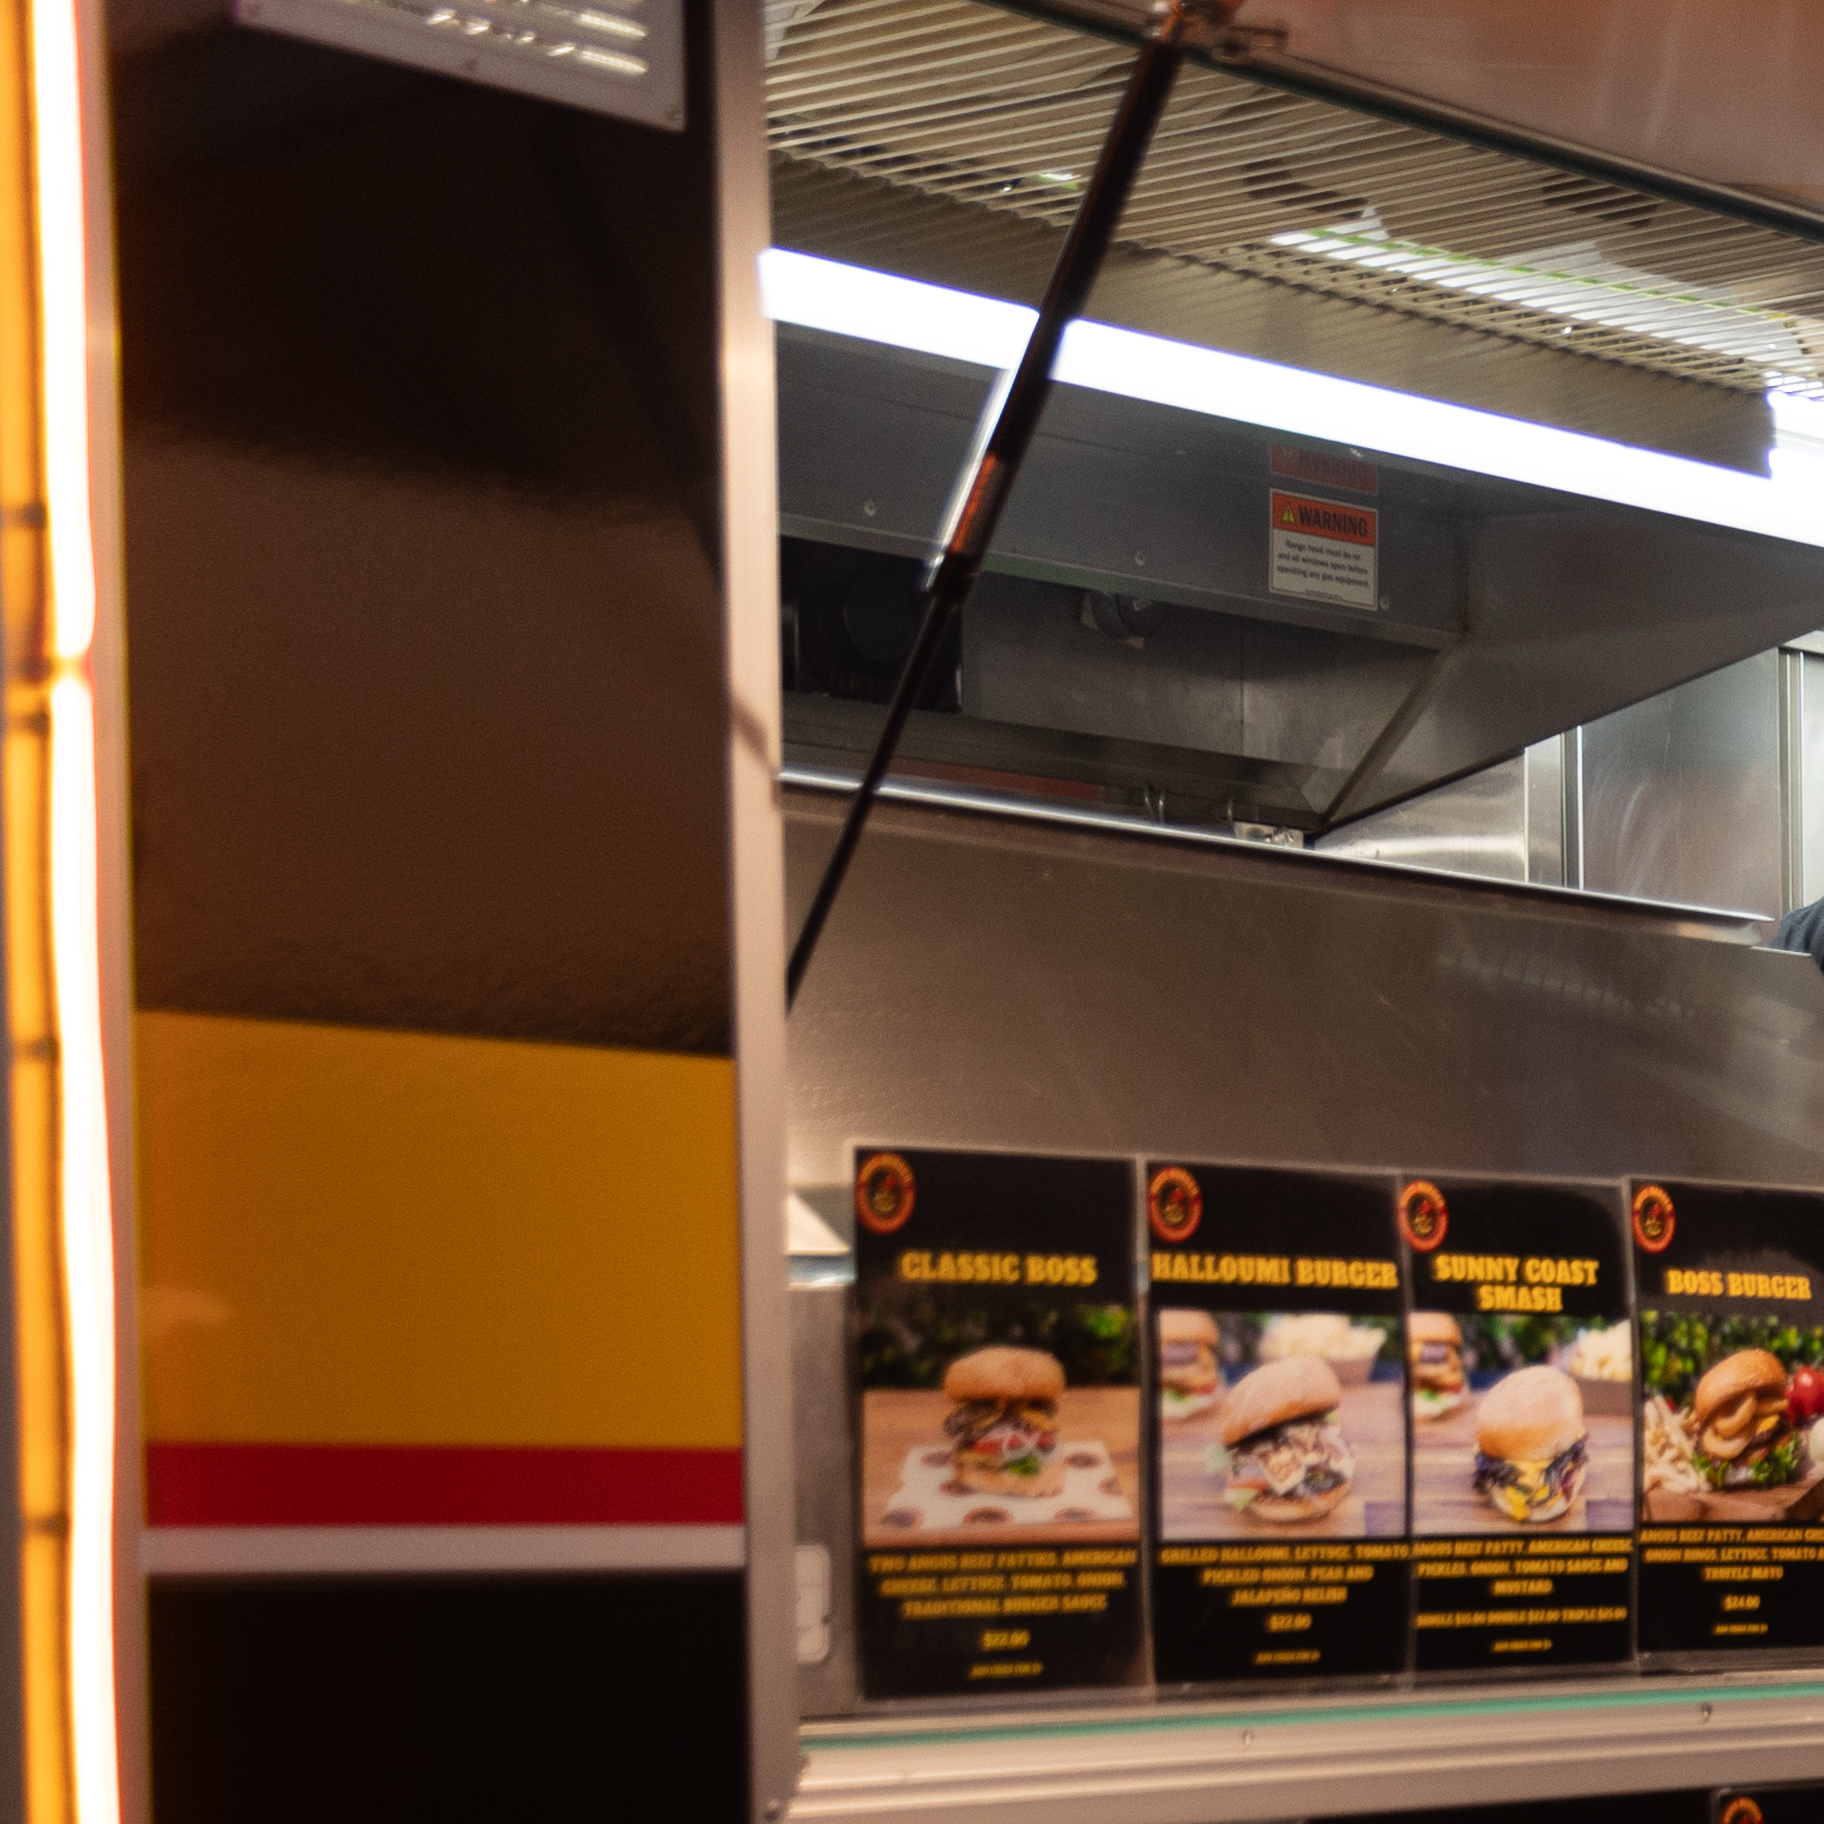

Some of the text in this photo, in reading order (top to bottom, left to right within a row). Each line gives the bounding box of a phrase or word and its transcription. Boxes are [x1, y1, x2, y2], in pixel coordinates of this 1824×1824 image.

[1299, 506, 1368, 537] WARNING
[900, 1250, 1098, 1286] CLASSIC BOSS
[1150, 1251, 1399, 1290] HALLOUMI BURGER
[1433, 1255, 1599, 1287] SUNNY COAST
[1667, 1269, 1812, 1302] BOSS BURGER
[1477, 1285, 1563, 1312] SMASH
[1527, 1537, 1590, 1556] AMERICAN
[1639, 1528, 1678, 1545] ANGUS
[1679, 1528, 1705, 1544] BEEF
[1746, 1528, 1804, 1543] AMERICAN
[1062, 1549, 1137, 1567] AMERICAN
[1159, 1546, 1218, 1565] GRILLED
[1643, 1548, 1682, 1564] ONION
[1771, 1547, 1817, 1561] TOMATO
[1202, 1563, 1375, 1586] PICKLED PEAR AND
[1514, 1557, 1566, 1576] TOMATO
[1604, 1556, 1629, 1574] AND
[1702, 1565, 1784, 1582] TRUFFLE MAYO
[1302, 1586, 1348, 1605] RELISH
[1491, 1577, 1554, 1597] MUSTARD
[901, 1598, 1000, 1619] TRADITIONAL
[1061, 1592, 1108, 1613] SAUCE
[1723, 1594, 1761, 1612] $24.00
[1562, 1607, 1597, 1624] TRIPLE
